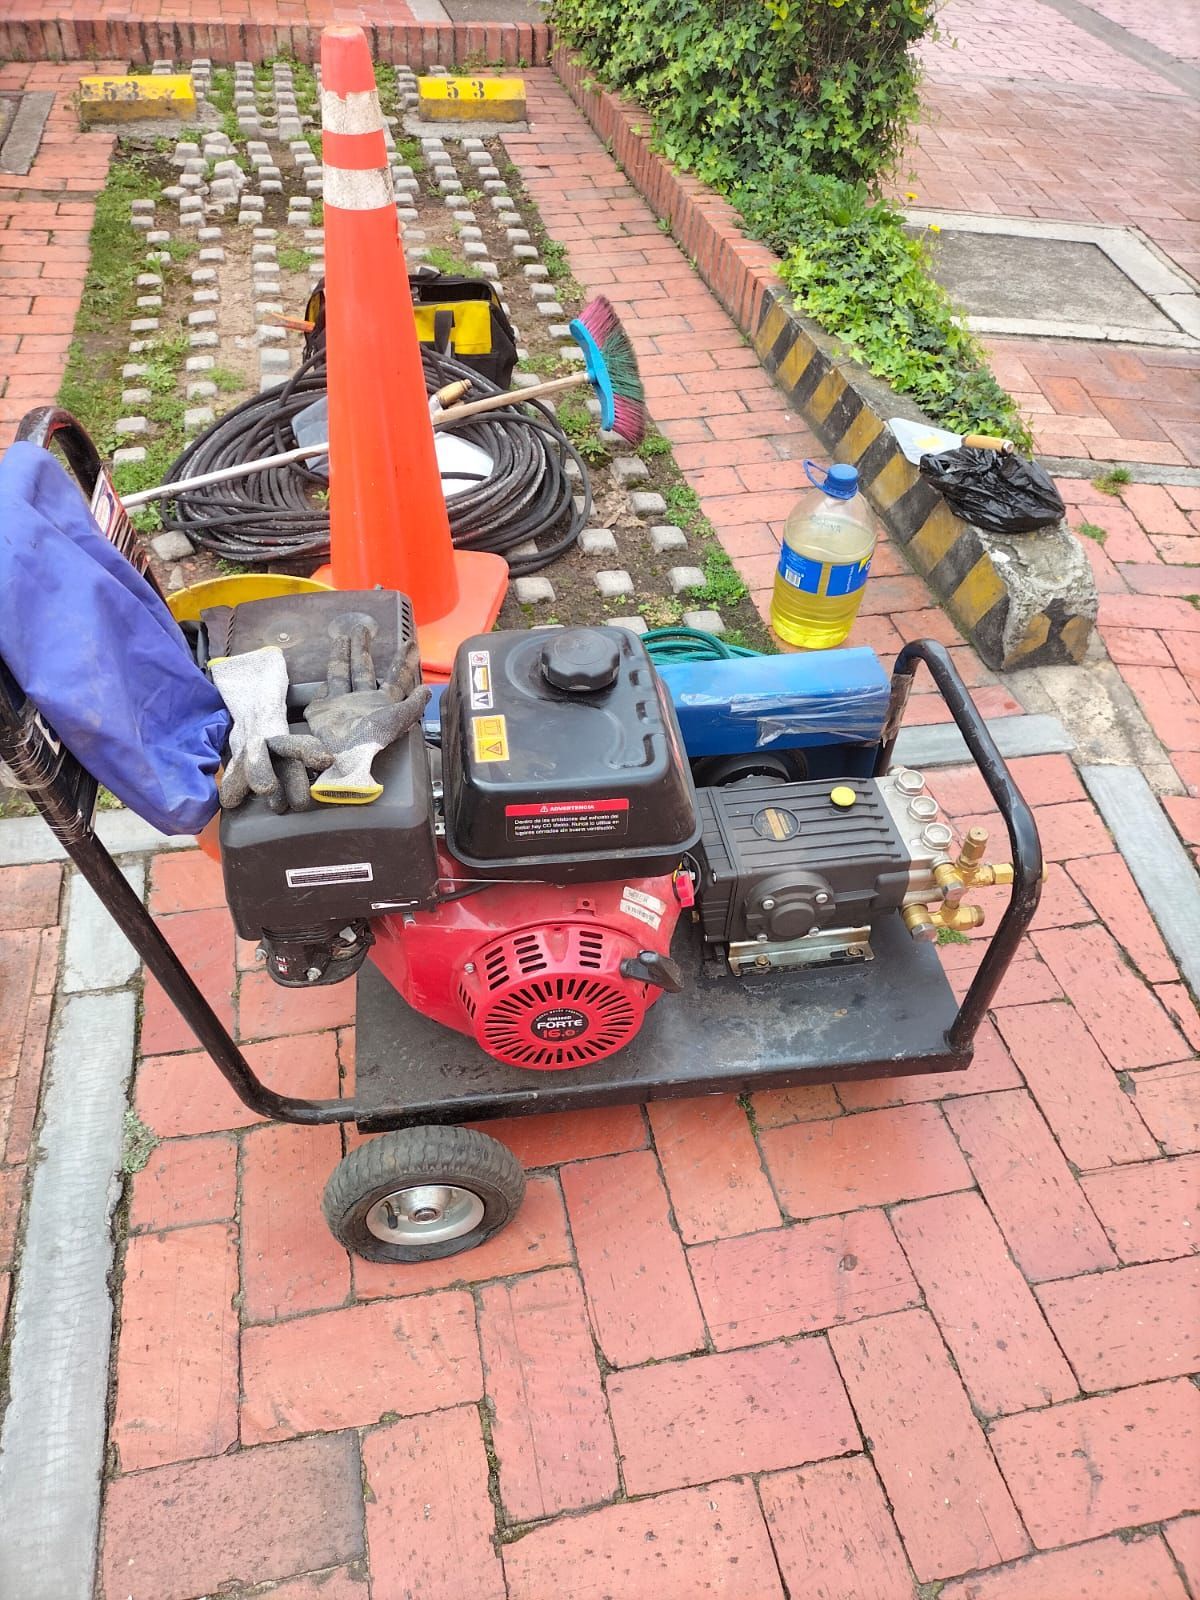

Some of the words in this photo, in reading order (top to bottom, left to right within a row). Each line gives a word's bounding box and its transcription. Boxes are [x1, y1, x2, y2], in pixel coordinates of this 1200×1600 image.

[549, 804, 595, 812] ADVERTENCIA
[537, 1019, 583, 1030] FORTE
[543, 1029, 576, 1038] 16.0
